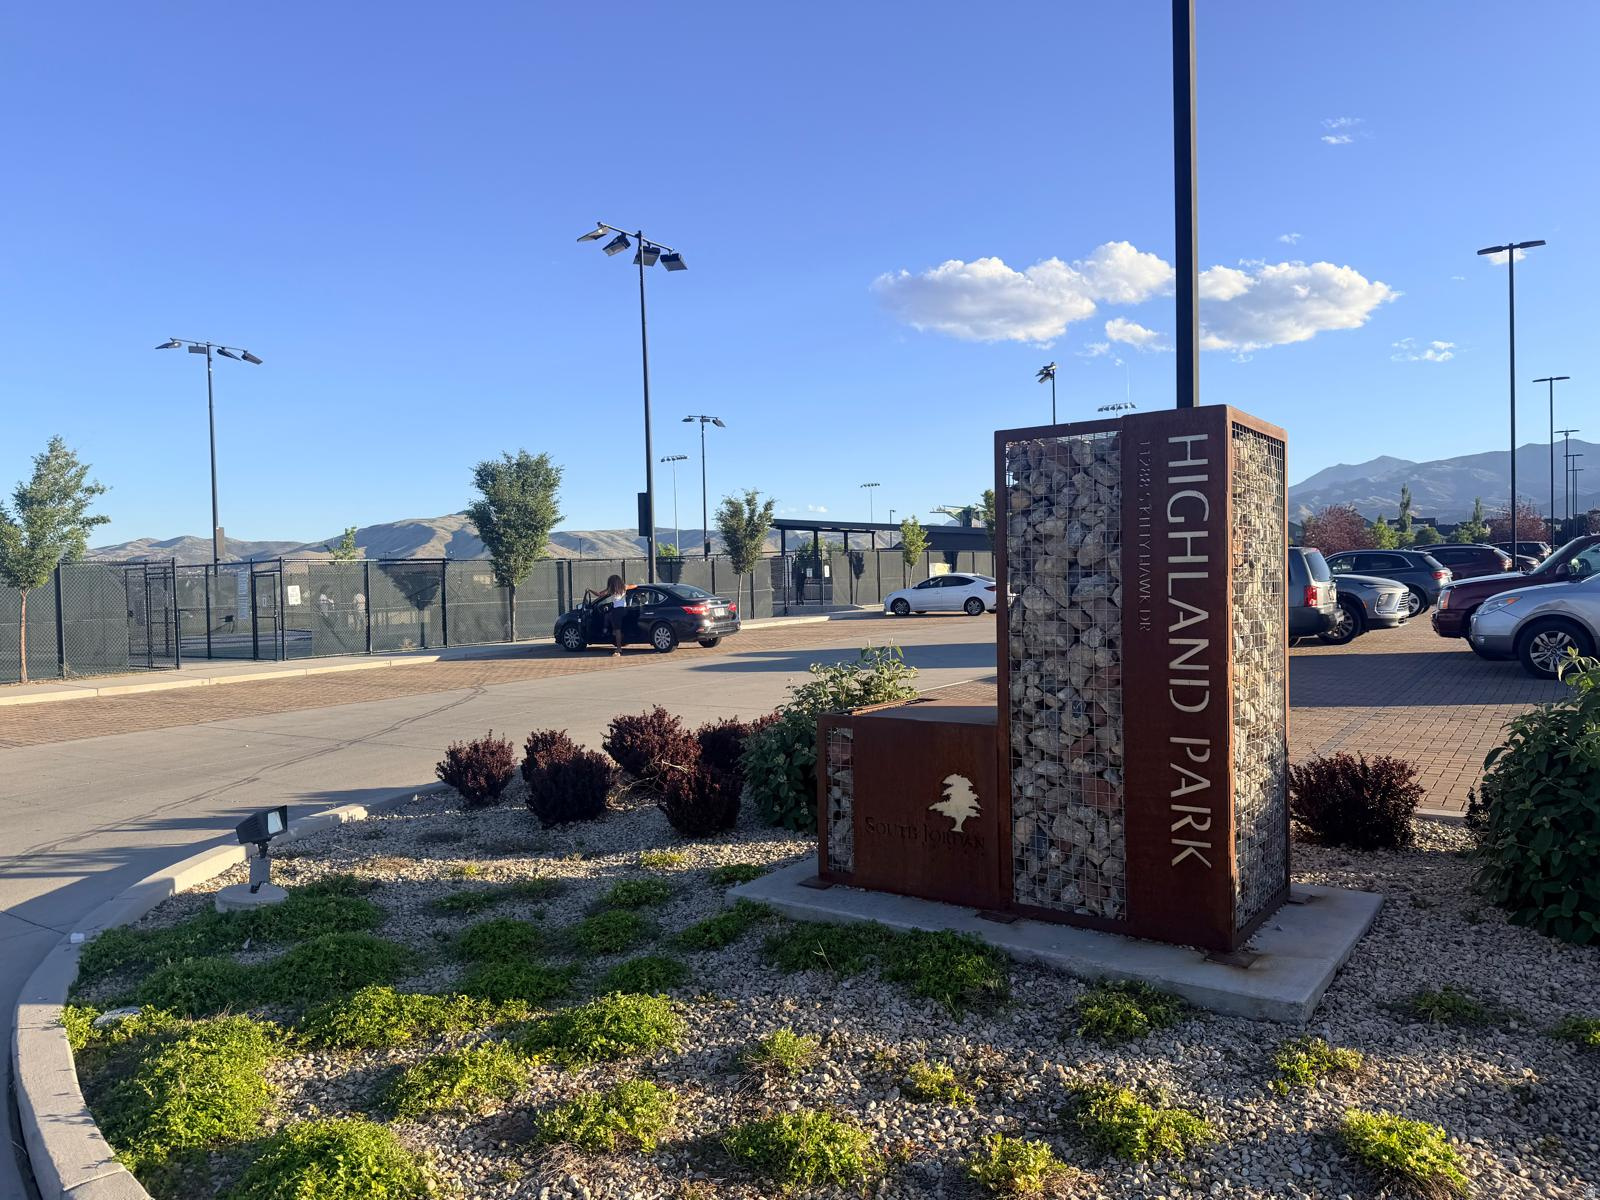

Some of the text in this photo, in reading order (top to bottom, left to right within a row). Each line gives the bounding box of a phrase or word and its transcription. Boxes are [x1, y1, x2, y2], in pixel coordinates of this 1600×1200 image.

[1138, 504, 1151, 551] KITTY
[1138, 554, 1151, 603] HAWK
[1138, 610, 1151, 632] DR
[1167, 434, 1212, 869] HIGHLAND PARK
